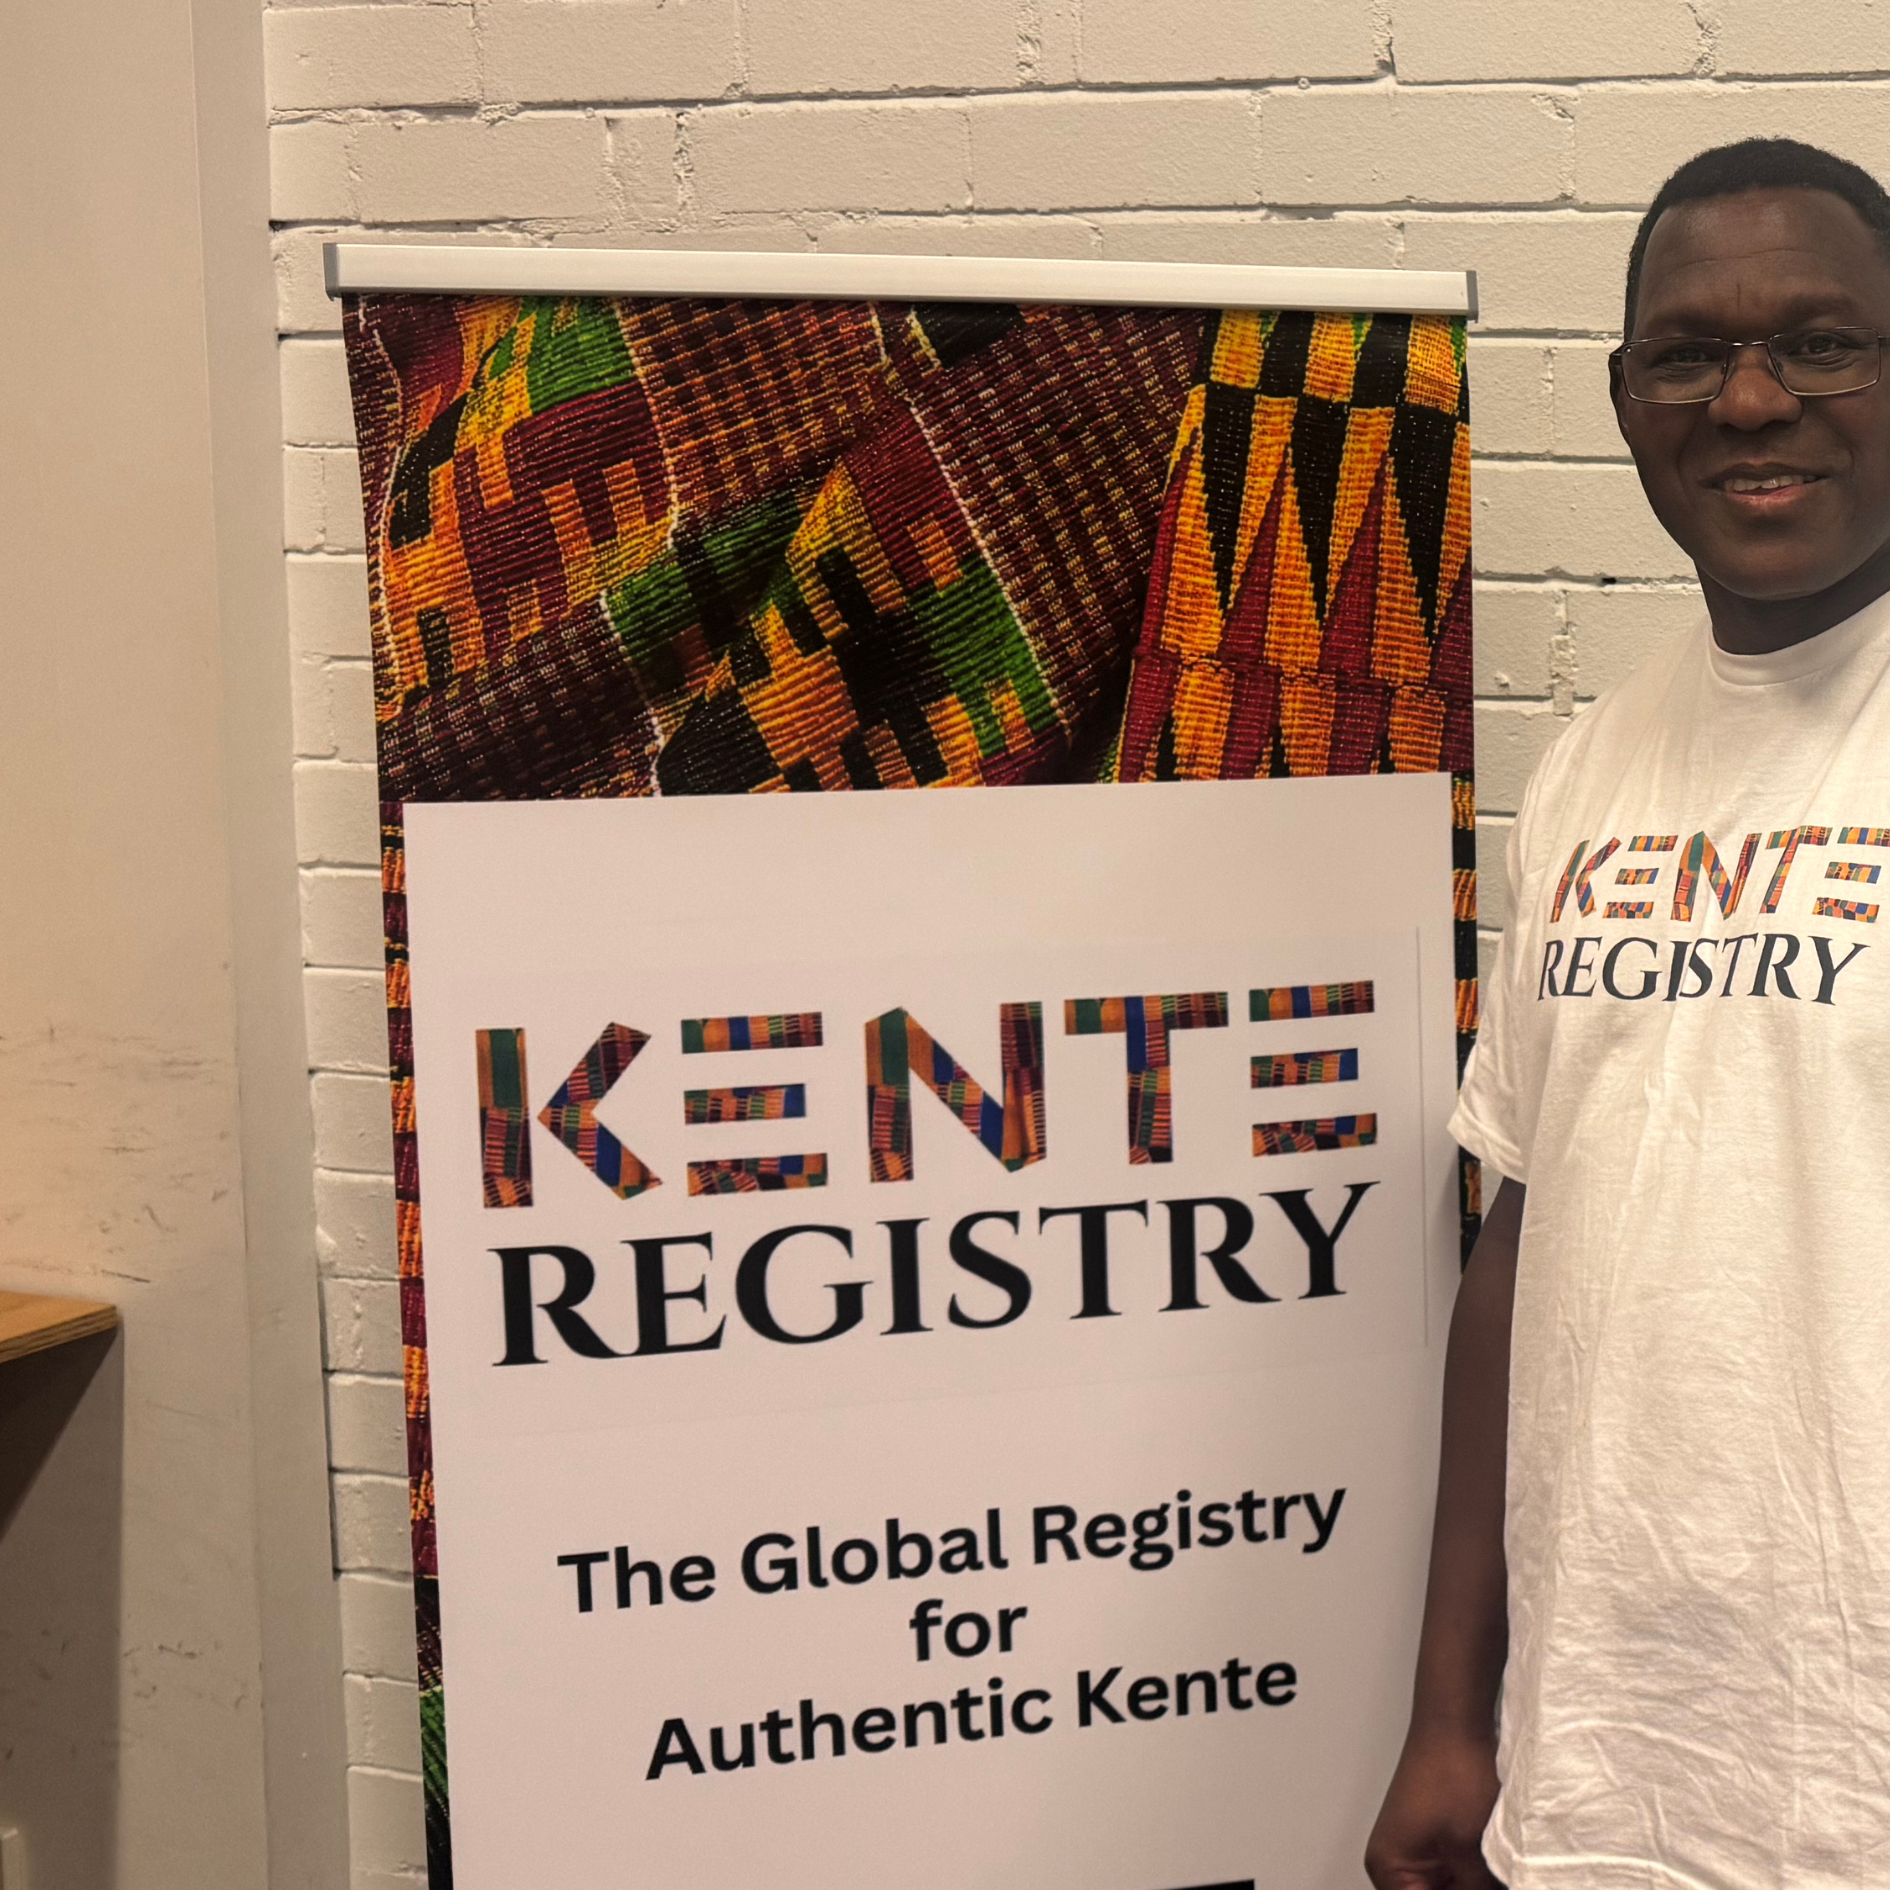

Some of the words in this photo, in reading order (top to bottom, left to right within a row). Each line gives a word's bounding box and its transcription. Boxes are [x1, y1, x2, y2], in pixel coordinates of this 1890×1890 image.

[1537, 933, 1871, 1006] REGISTRY
[476, 980, 1377, 1208] KENTE
[487, 1180, 1381, 1367] REGISTRY
[557, 1546, 717, 1614] The
[740, 1508, 1009, 1596] Global
[1032, 1487, 1347, 1572] Registry
[909, 1599, 1028, 1662] for
[645, 1677, 1053, 1781] Authentic
[1076, 1657, 1298, 1728] Kente
